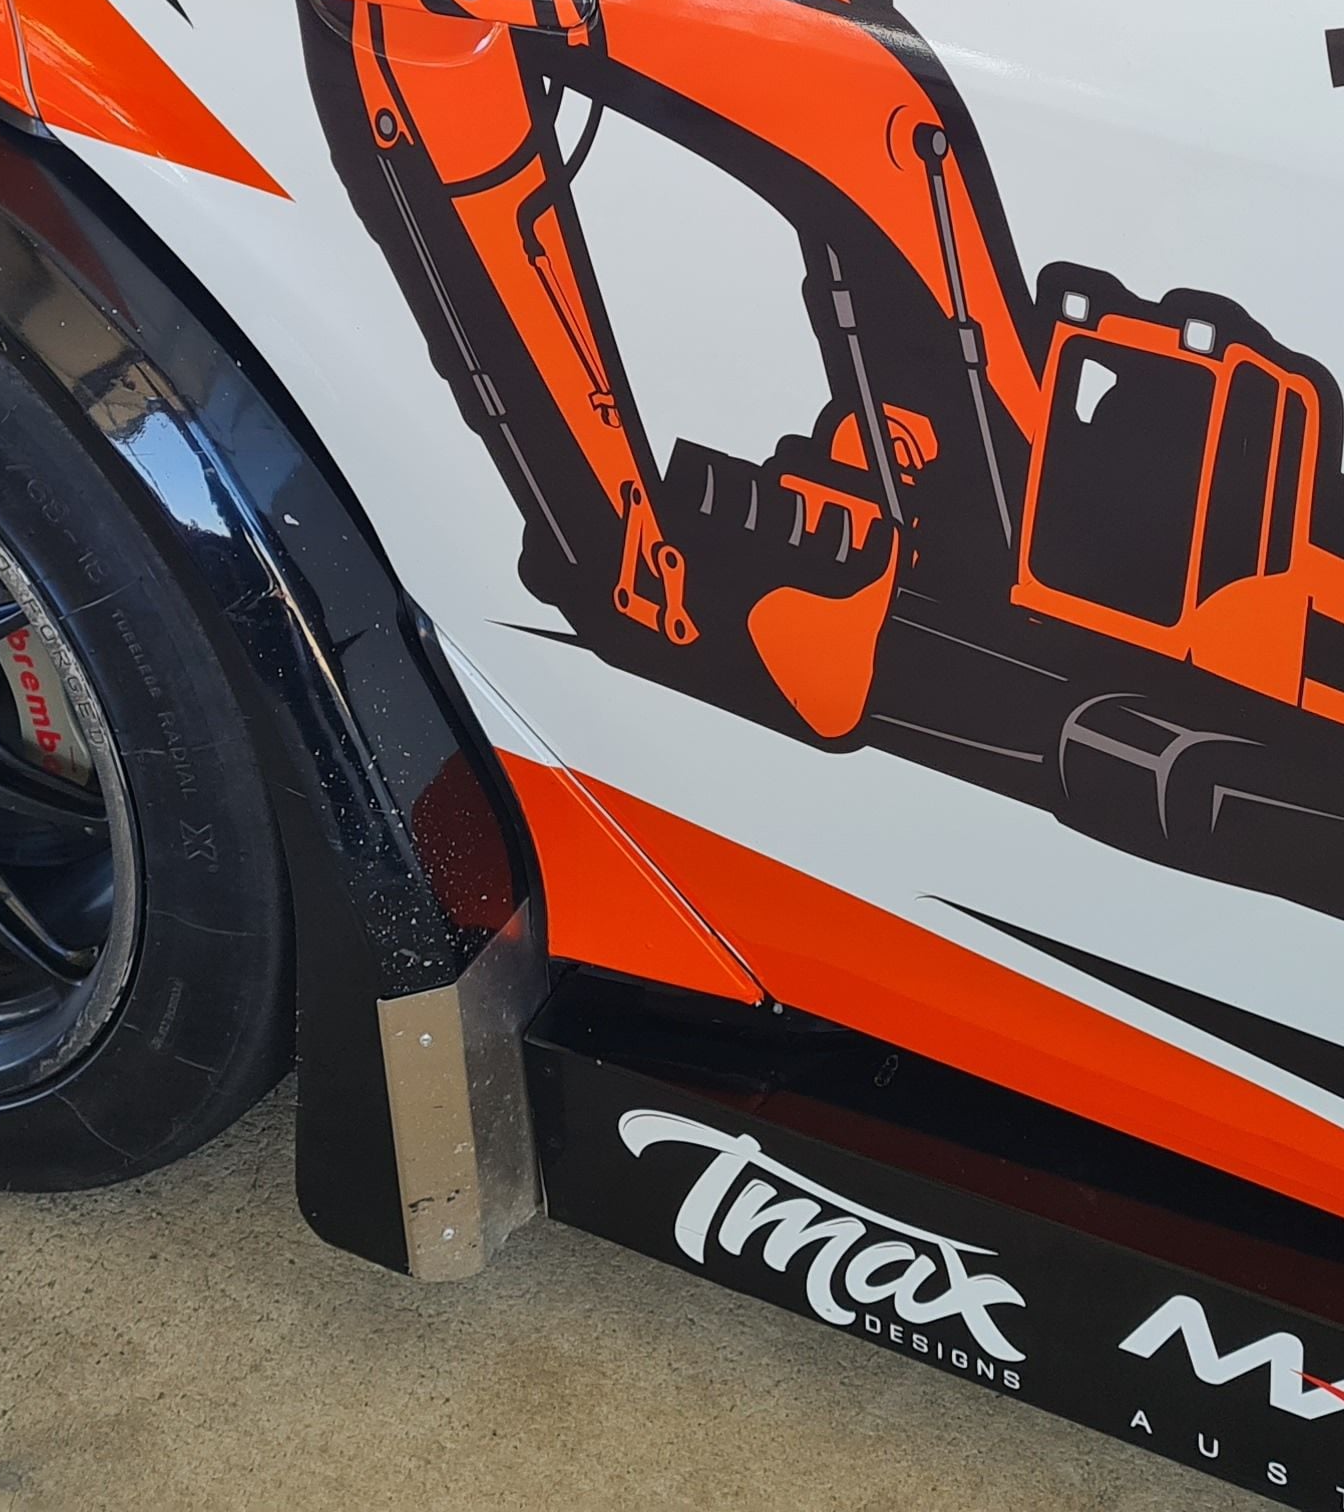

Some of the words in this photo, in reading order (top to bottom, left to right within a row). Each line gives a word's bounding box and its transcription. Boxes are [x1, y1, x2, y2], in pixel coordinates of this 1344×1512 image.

[22, 596, 108, 749] FORGED
[158, 711, 198, 795] RADIAL
[617, 1108, 1028, 1363] Tmax
[863, 1314, 1022, 1392] DESIGNS
